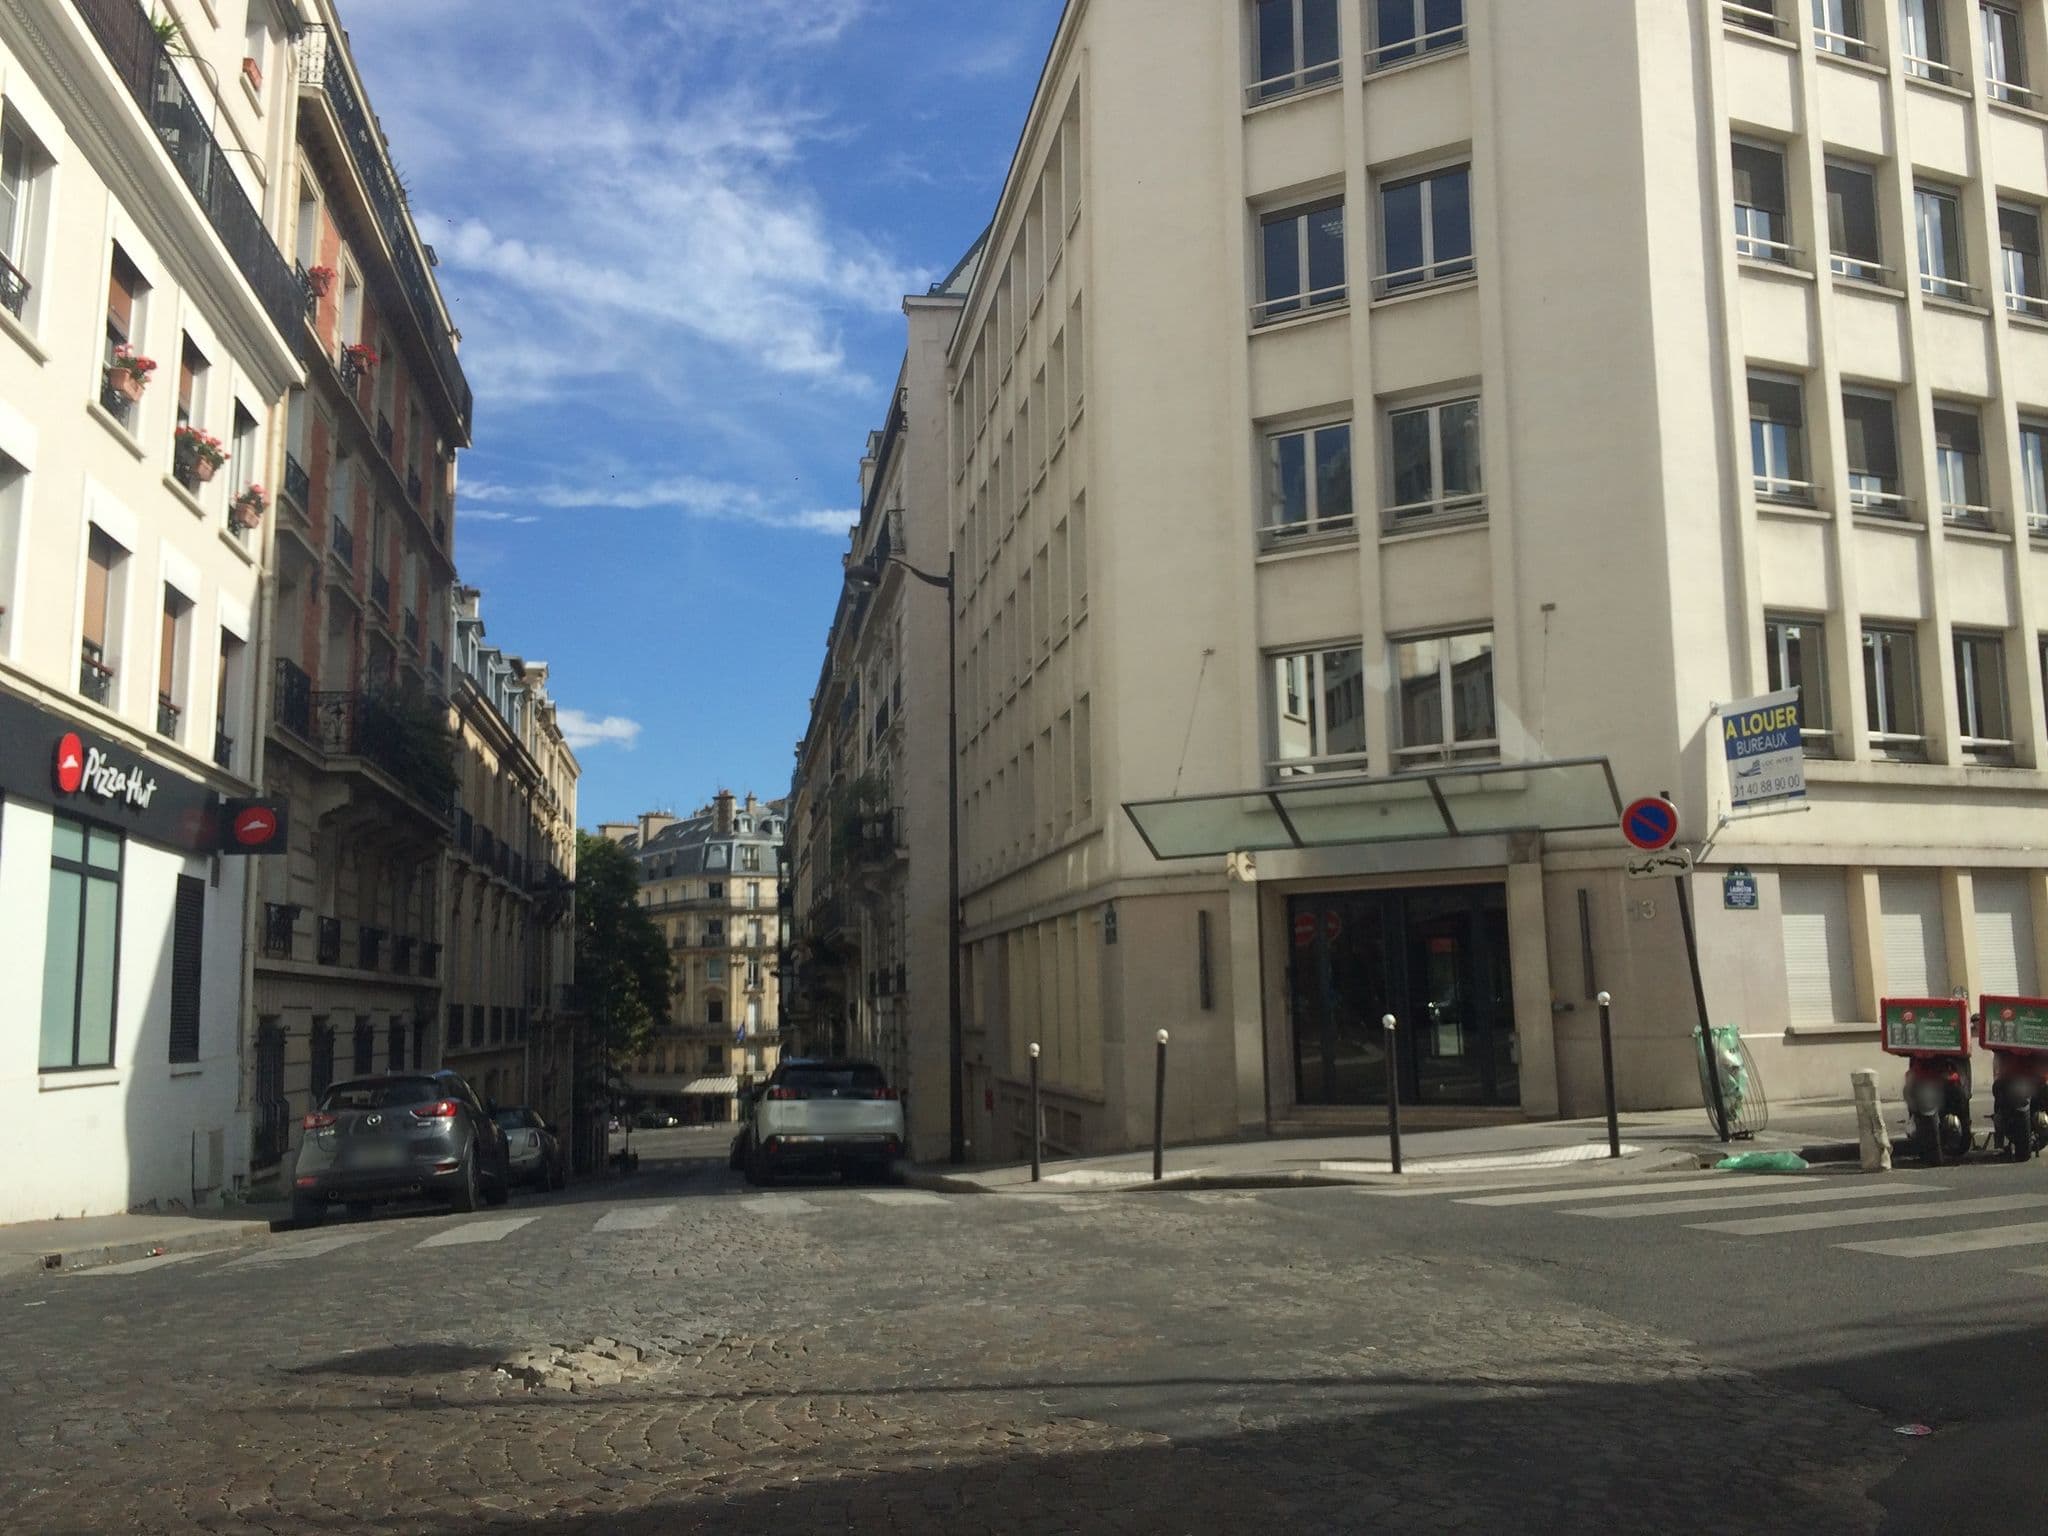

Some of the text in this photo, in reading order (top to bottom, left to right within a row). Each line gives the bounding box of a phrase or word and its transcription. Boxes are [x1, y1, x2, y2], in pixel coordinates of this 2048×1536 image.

[1726, 705, 1798, 741] A LOUER
[1736, 732, 1789, 756] BUREAUX
[80, 747, 158, 808] Pizza Hut
[1747, 782, 1759, 795] 40
[1788, 773, 1800, 788] 00
